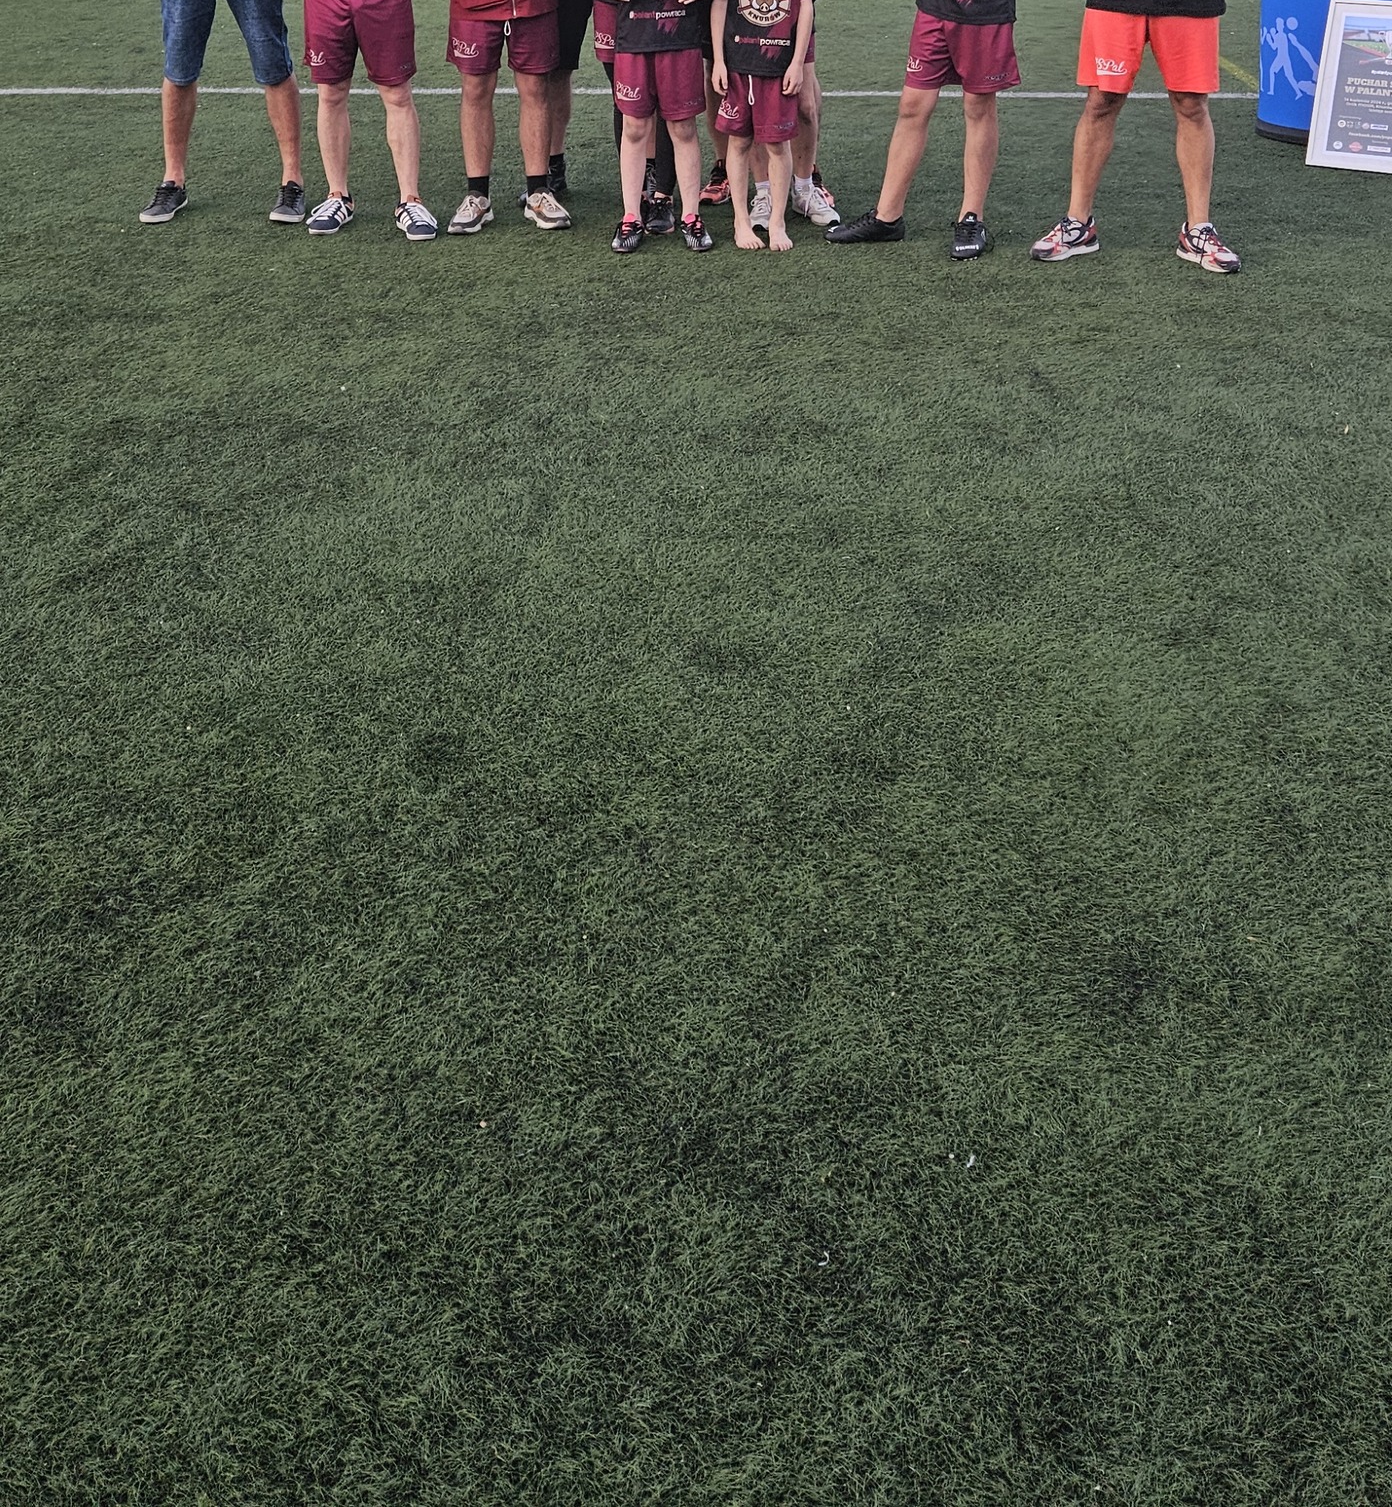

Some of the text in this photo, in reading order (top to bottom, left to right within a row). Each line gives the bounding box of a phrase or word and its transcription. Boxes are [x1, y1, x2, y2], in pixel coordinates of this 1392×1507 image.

[452, 37, 477, 55] PPal
[1347, 77, 1388, 88] PUCHAR
[1344, 86, 1392, 97] W PALAN
